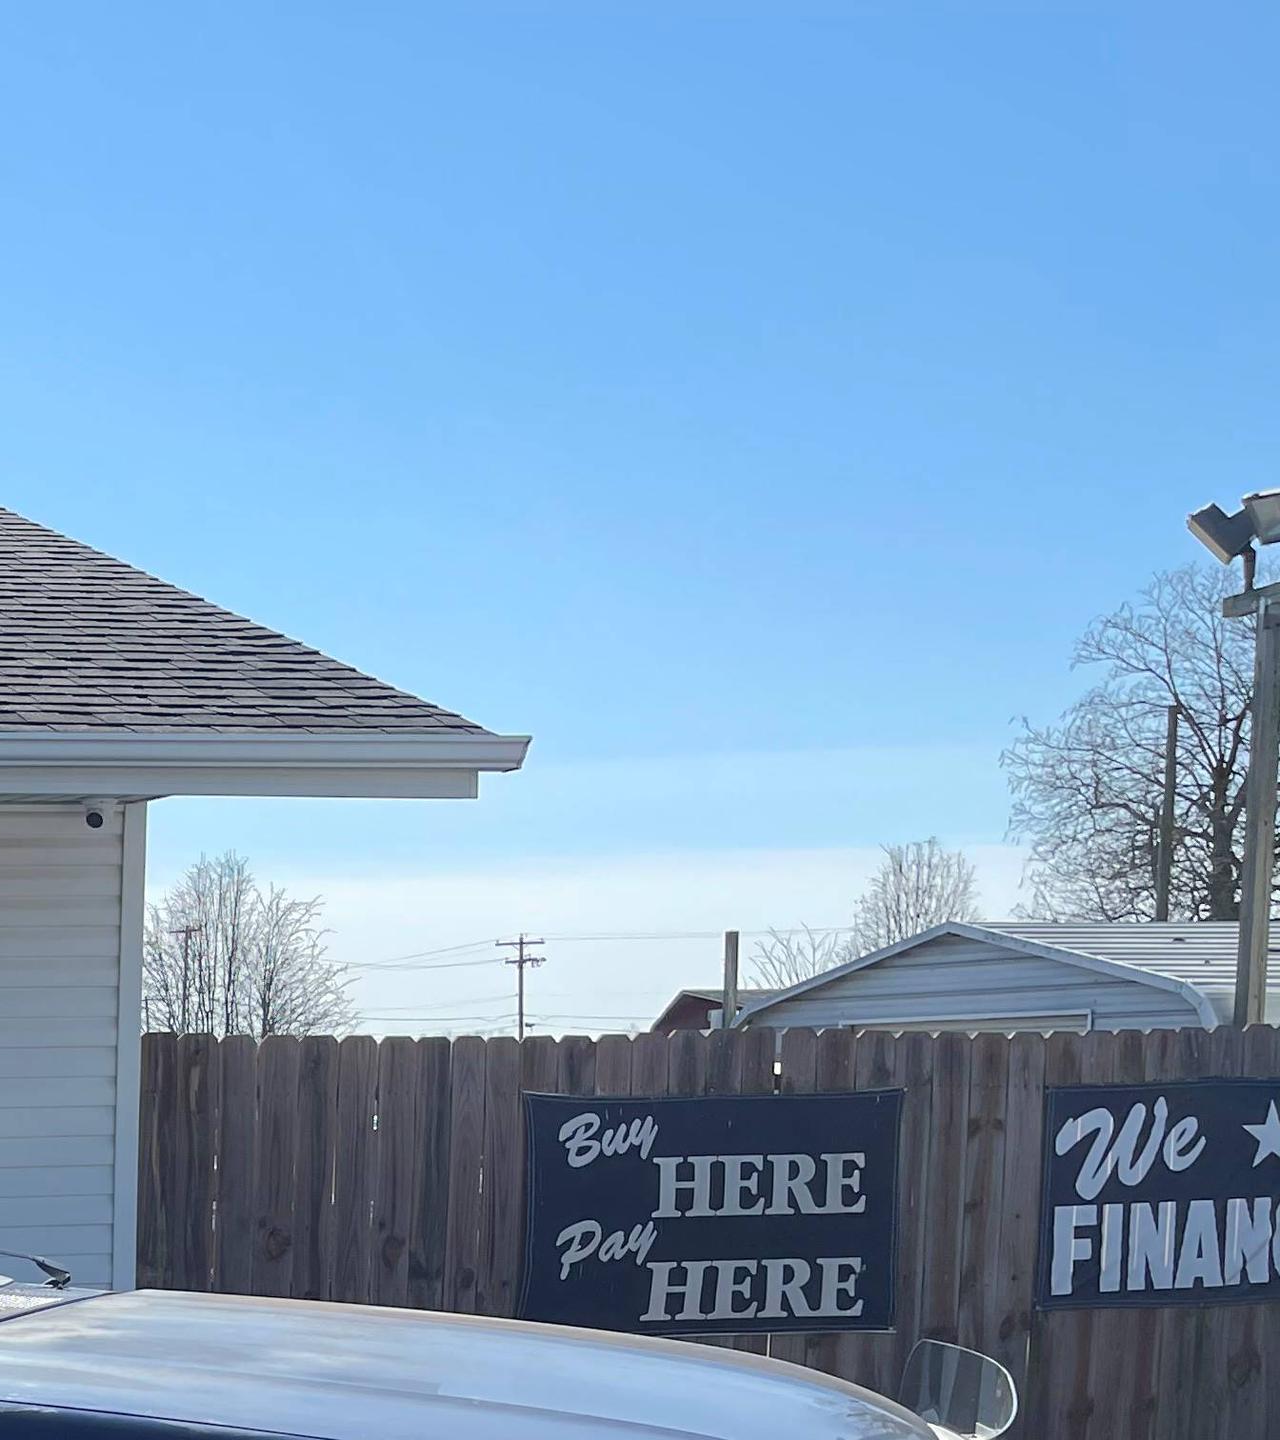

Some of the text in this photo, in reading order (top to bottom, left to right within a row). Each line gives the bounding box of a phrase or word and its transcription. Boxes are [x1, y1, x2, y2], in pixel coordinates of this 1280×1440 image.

[558, 1112, 658, 1168] Buy
[1055, 1096, 1207, 1201] We
[651, 1152, 866, 1218] HERE
[555, 1219, 658, 1281] Pay
[1050, 1196, 1280, 1296] FINAN
[640, 1256, 864, 1322] HERE
